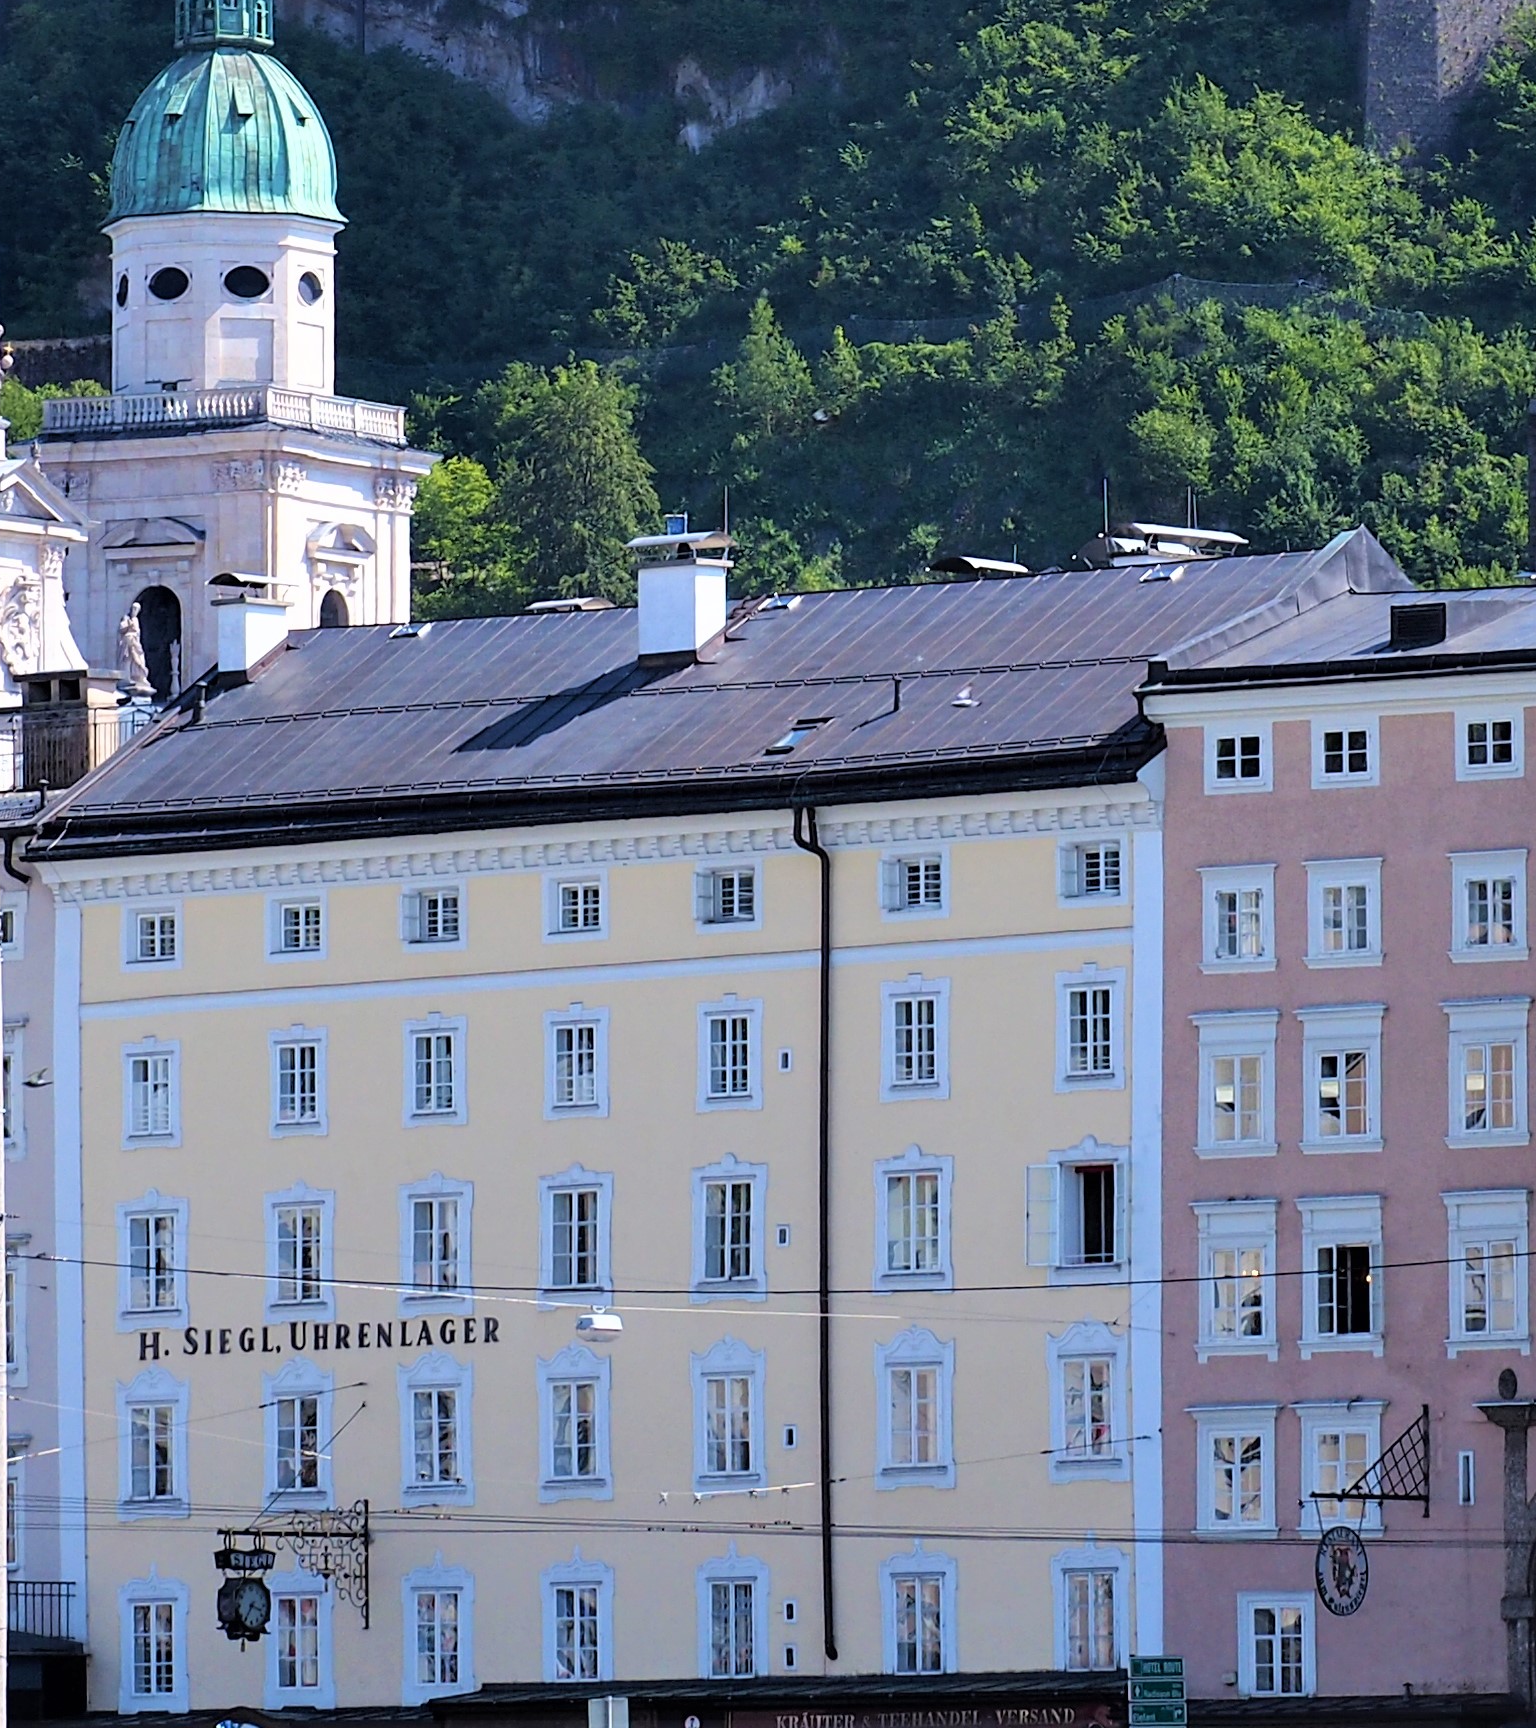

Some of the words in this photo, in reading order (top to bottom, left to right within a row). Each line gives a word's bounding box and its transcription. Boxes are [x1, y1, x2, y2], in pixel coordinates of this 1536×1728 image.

[139, 1332, 170, 1361] H.
[290, 1317, 500, 1351] UHRENLAGER
[776, 1712, 855, 1728] KRÄUTER
[878, 1709, 981, 1727] TEEHANDEL
[995, 1707, 1075, 1724] VERSAND
